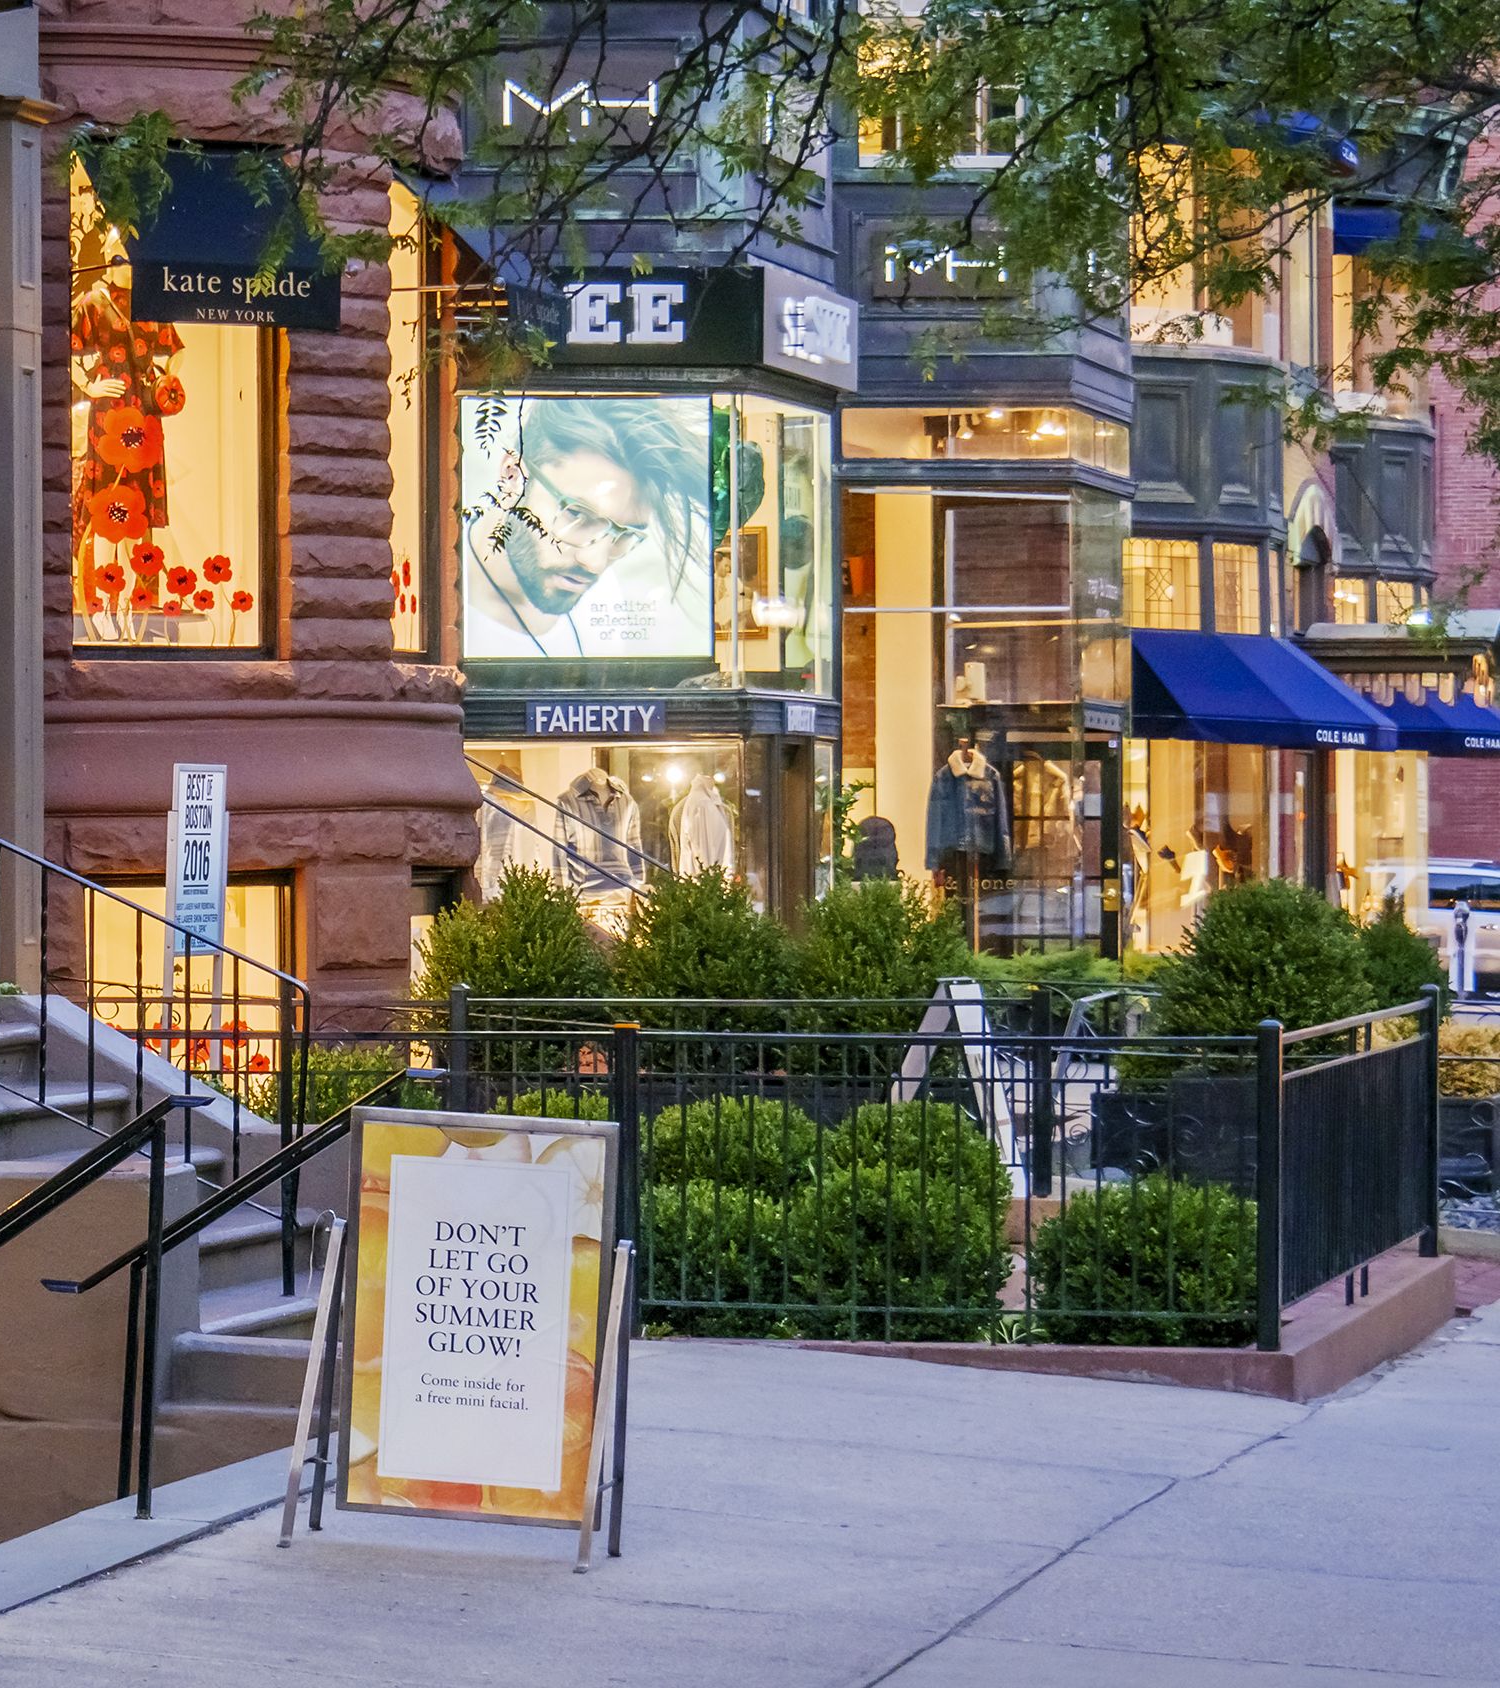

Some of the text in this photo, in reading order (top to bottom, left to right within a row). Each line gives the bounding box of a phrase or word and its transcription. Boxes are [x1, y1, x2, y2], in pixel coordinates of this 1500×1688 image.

[162, 266, 311, 304] kate spade
[196, 308, 275, 323] NEW YORK
[590, 600, 657, 613] an edited
[589, 615, 657, 627] selection
[599, 628, 650, 641] of cool
[534, 705, 656, 733] FAHERTY
[1315, 729, 1366, 745] COLE HAAN
[1464, 736, 1485, 748] COLE
[186, 774, 206, 801] BEST
[185, 804, 212, 829] BOSTON
[183, 839, 210, 881] 2016
[435, 1221, 526, 1247] DON'T
[429, 1248, 528, 1275] LET GO
[416, 1275, 540, 1304] OF YOUR
[415, 1302, 537, 1331] SUMMER
[428, 1331, 521, 1358] GLOW!
[421, 1372, 526, 1393] Come inside for
[415, 1390, 529, 1411] a free mini facial.
